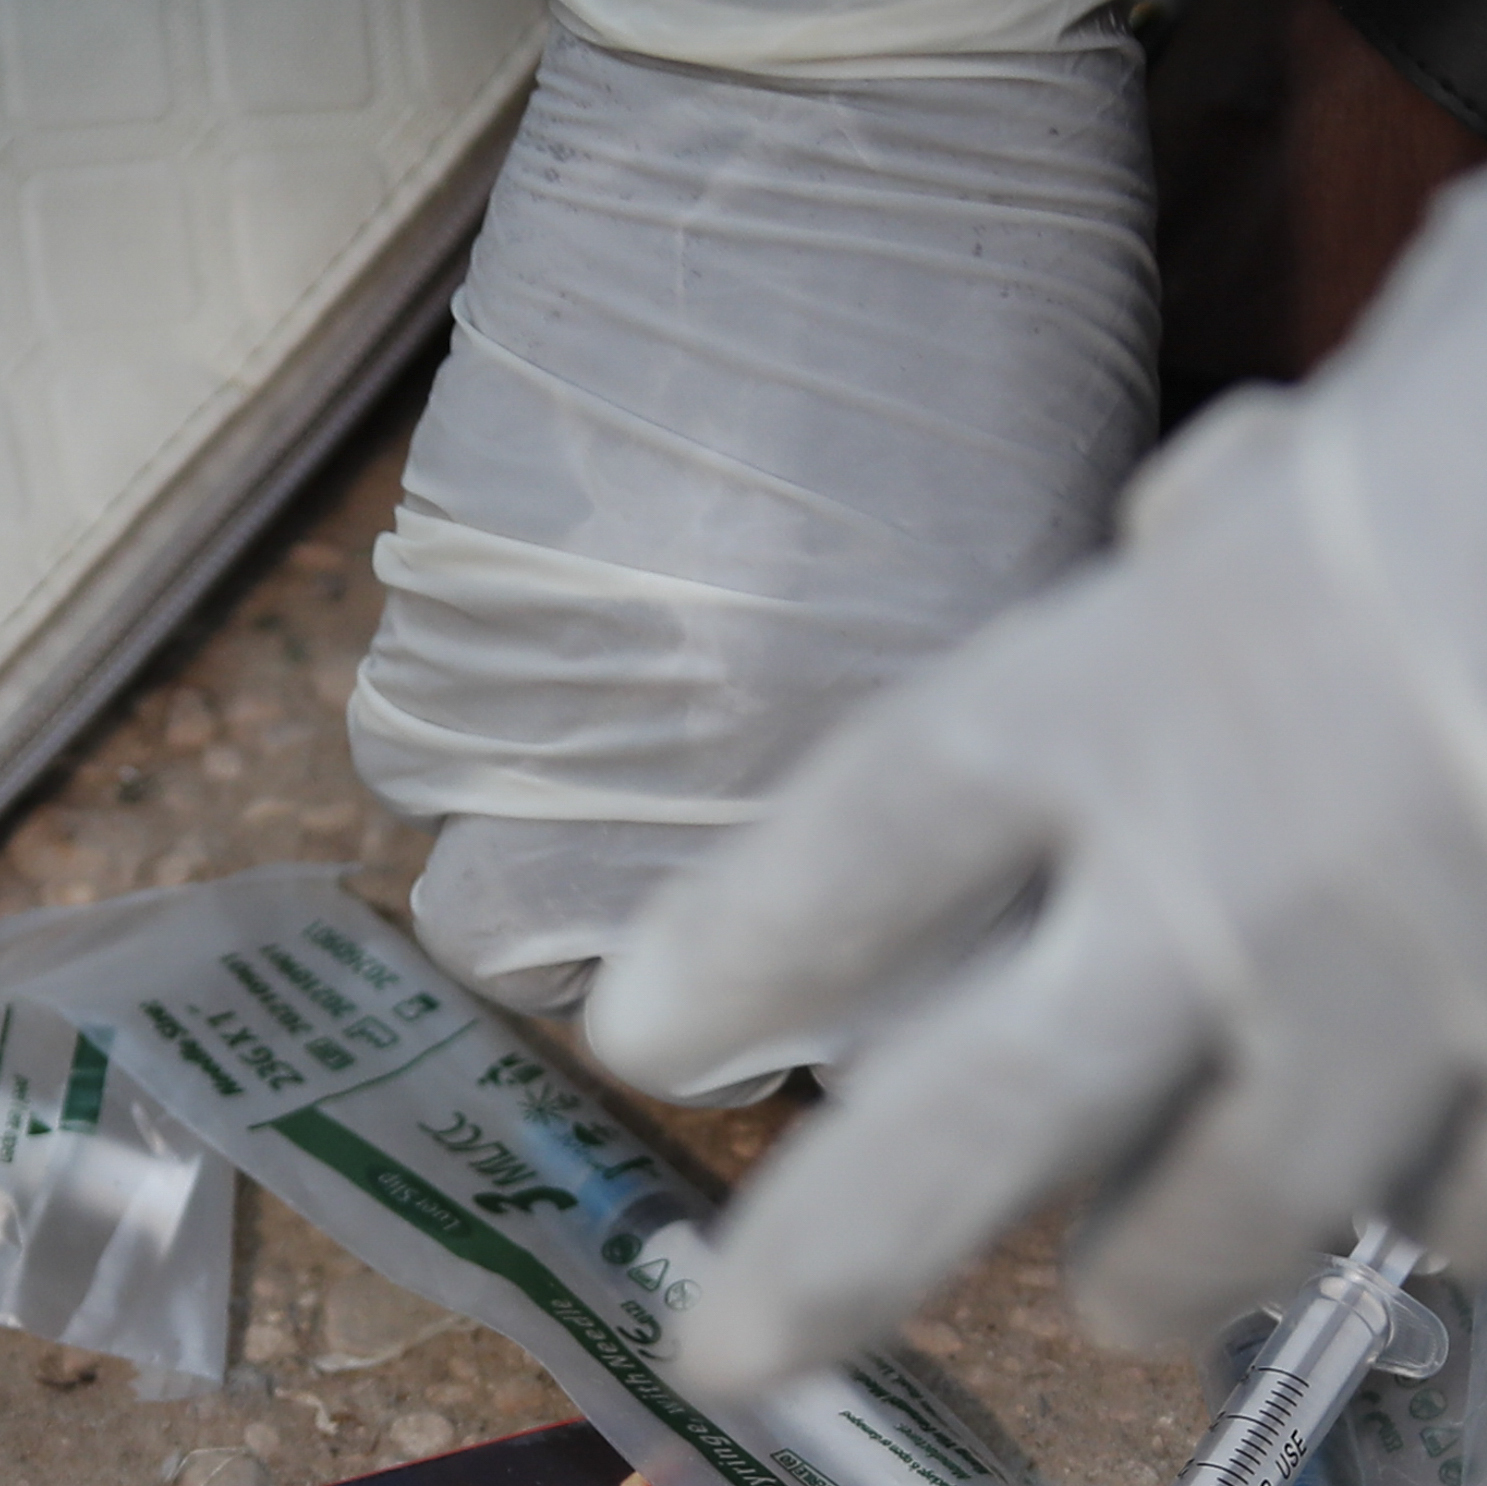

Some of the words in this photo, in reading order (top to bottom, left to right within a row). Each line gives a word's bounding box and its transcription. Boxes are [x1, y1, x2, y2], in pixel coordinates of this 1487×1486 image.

[236, 1036, 306, 1093] 23G
[409, 1194, 461, 1231] Luer
[548, 1291, 634, 1371] Needle
[1274, 1428, 1310, 1480] USE
